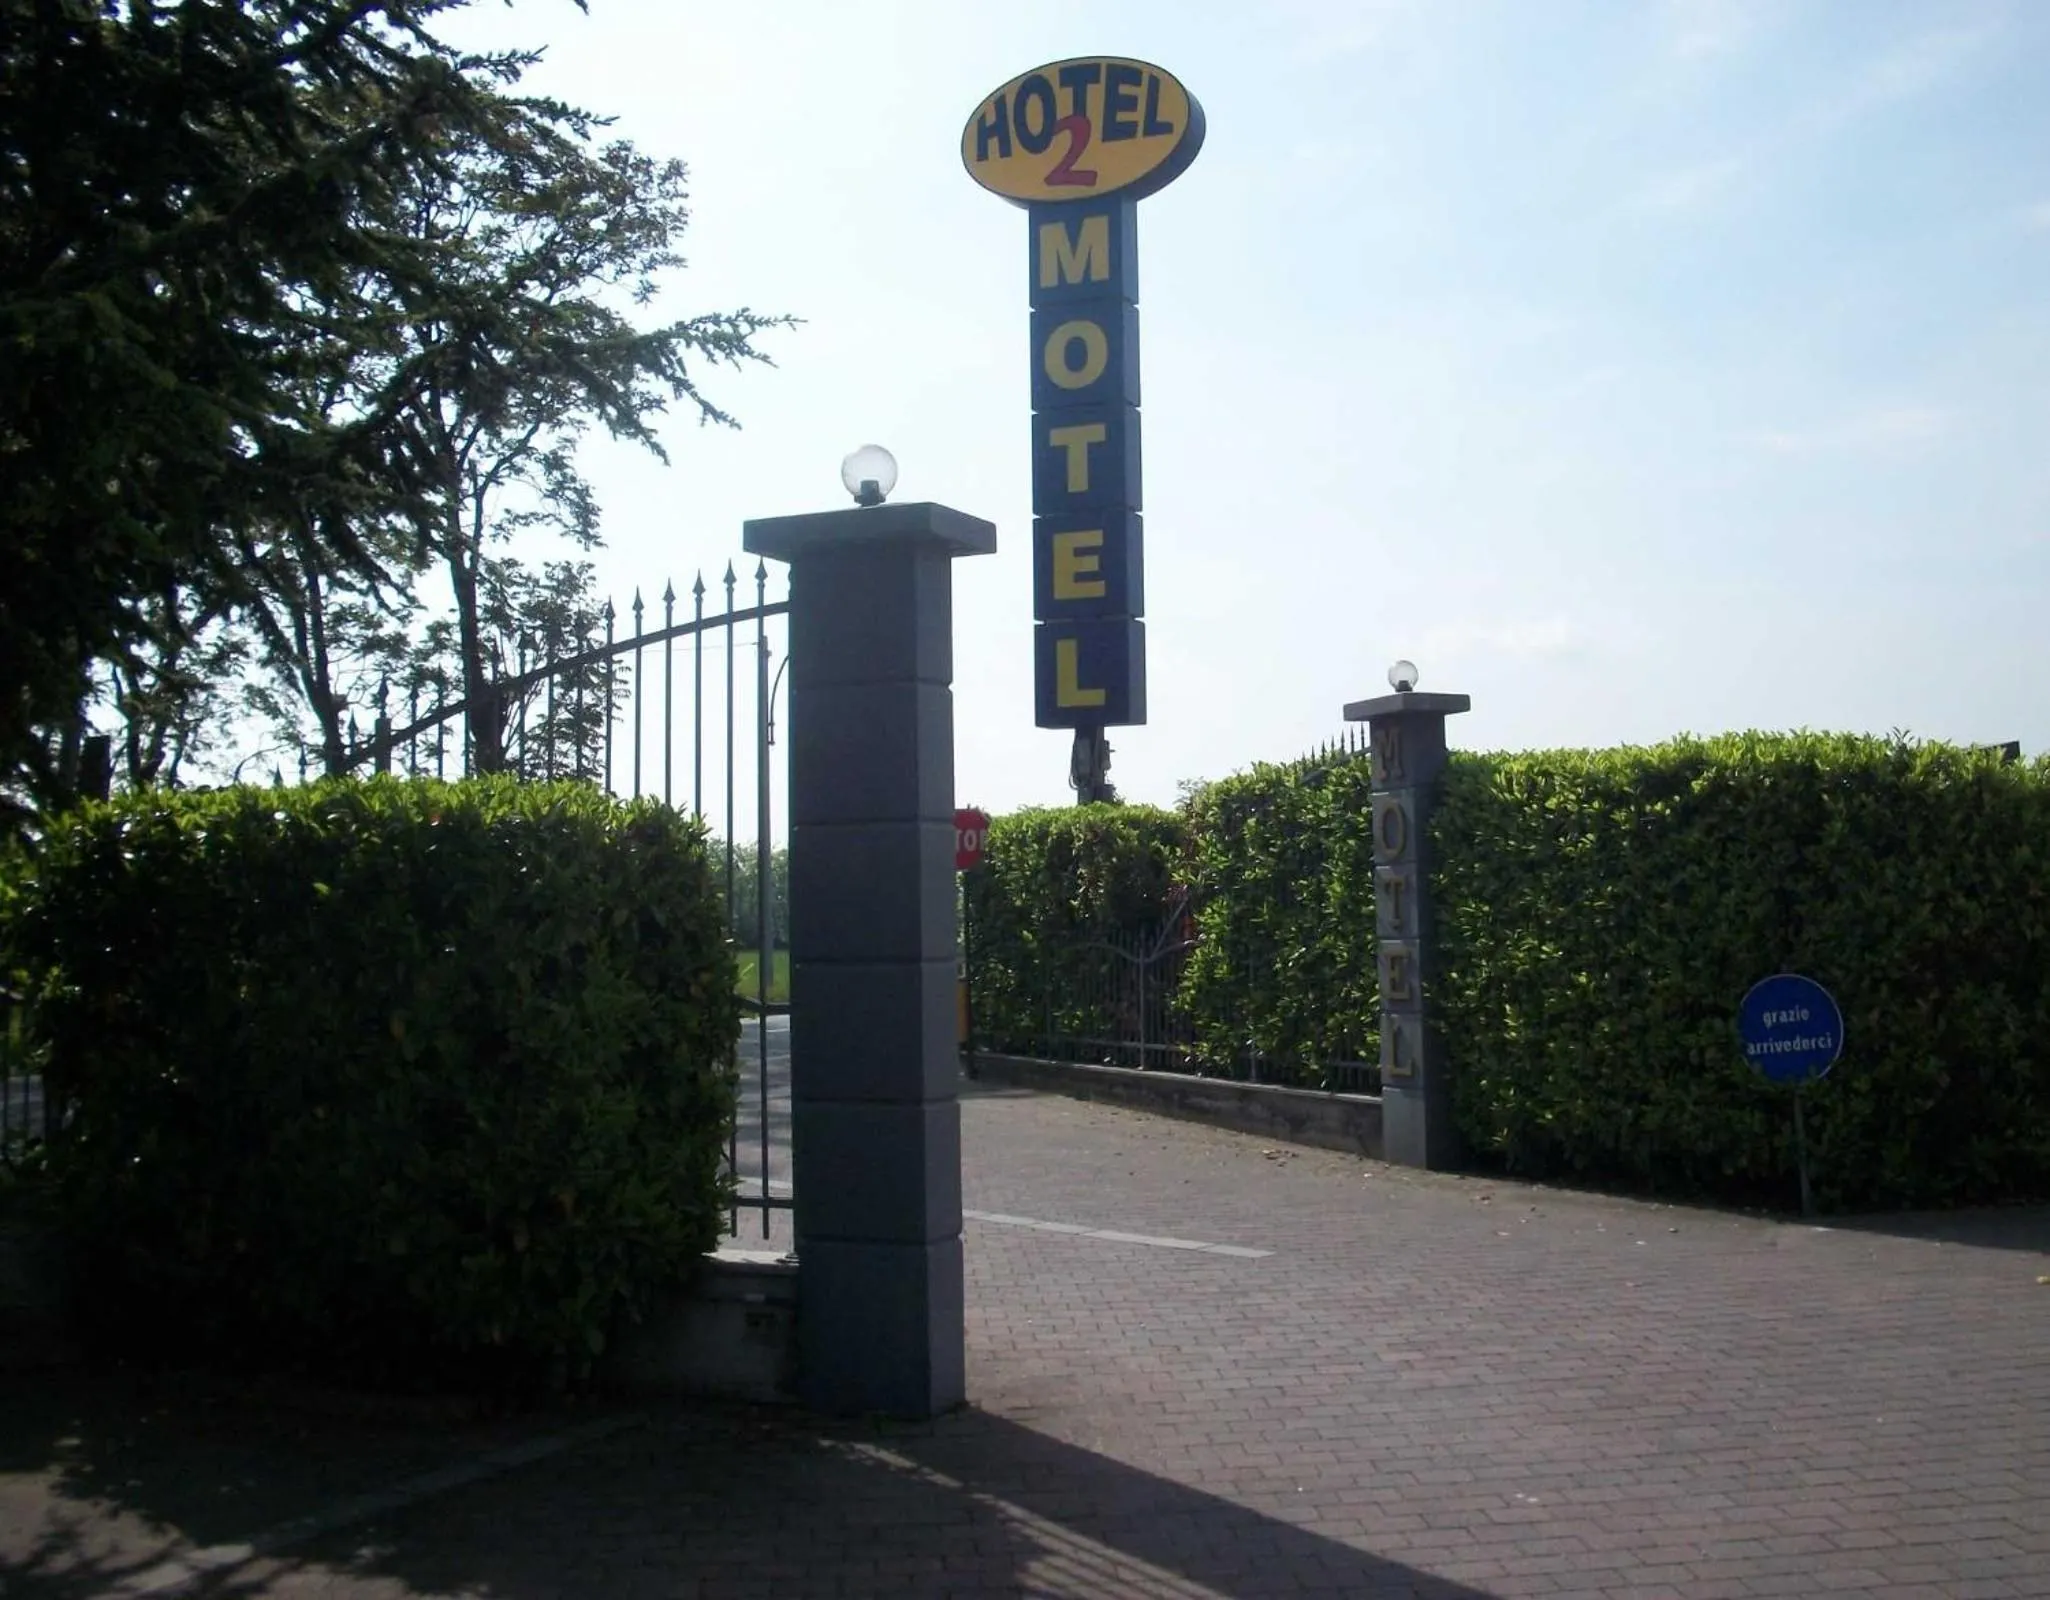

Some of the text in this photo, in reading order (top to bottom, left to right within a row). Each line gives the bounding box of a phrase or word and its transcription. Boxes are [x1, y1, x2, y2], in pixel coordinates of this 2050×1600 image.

[976, 62, 1173, 162] HOTEL
[1043, 114, 1098, 186] 2
[1038, 214, 1110, 709] MOTEL
[1374, 725, 1415, 1079] MOTEL
[1746, 1032, 1833, 1056] arrivederci
